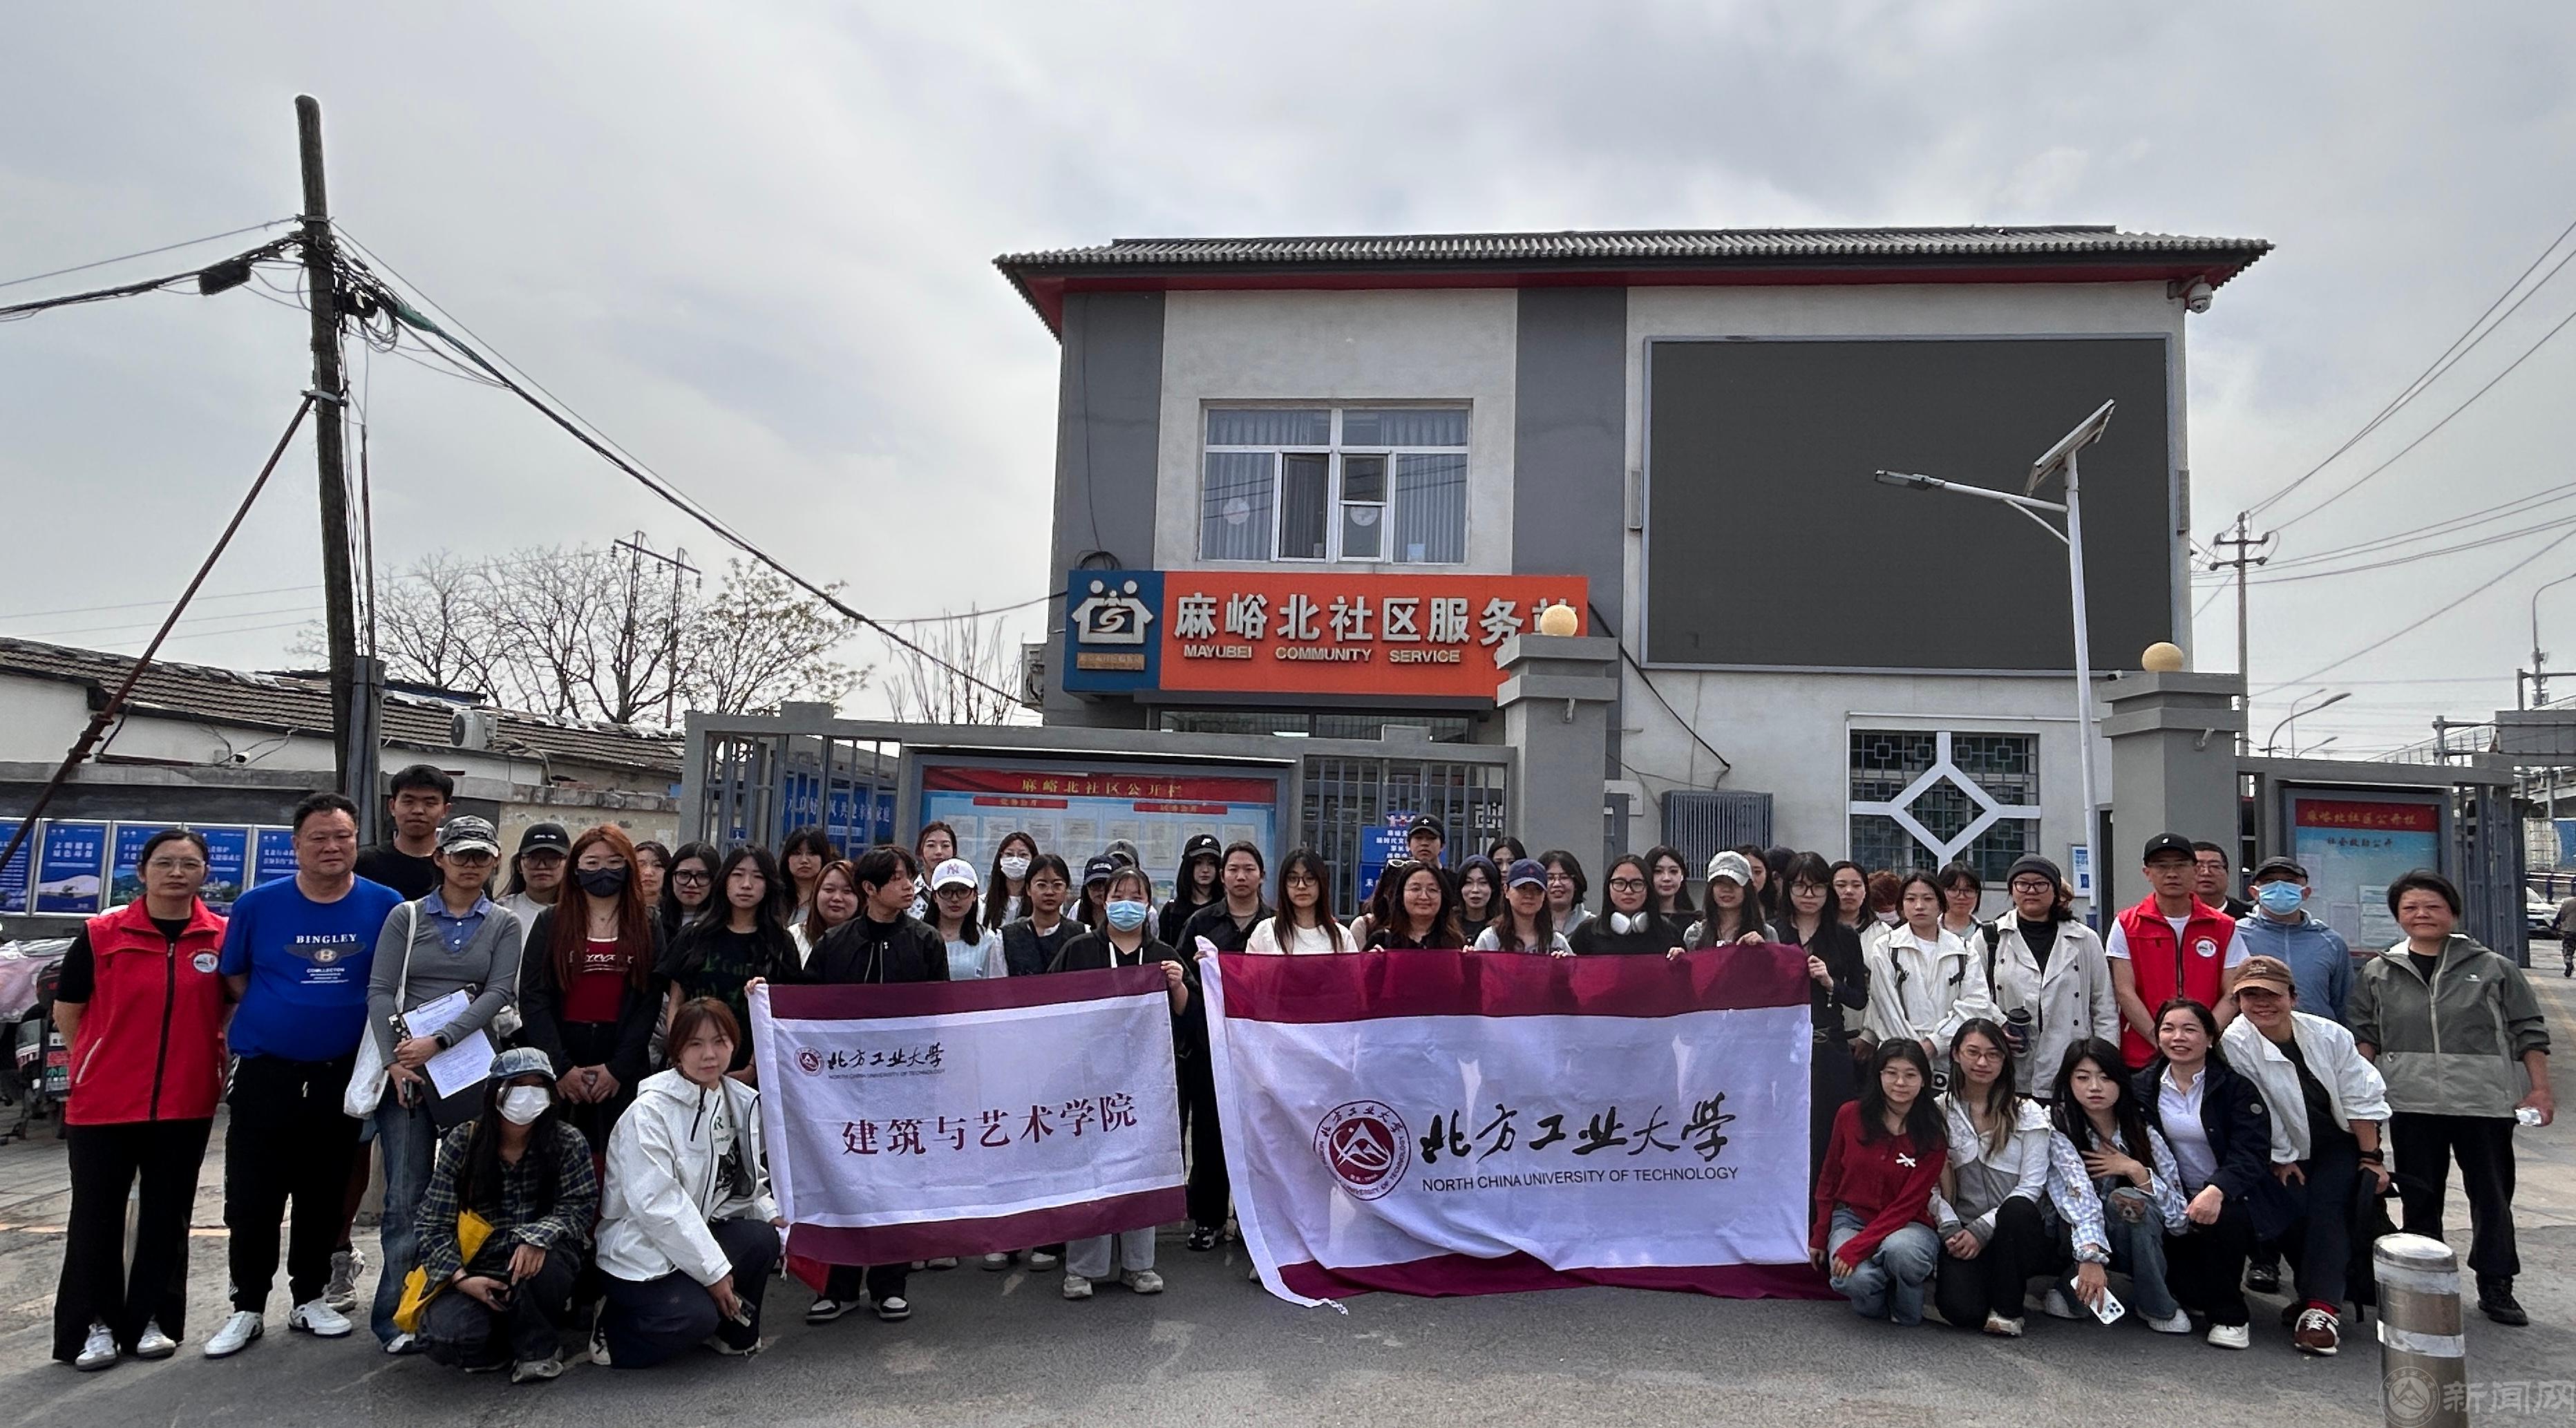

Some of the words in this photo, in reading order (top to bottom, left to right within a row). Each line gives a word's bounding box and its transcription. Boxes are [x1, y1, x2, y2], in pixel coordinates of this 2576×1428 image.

[1184, 645, 1252, 658] MAYUBEI
[1276, 646, 1372, 661] COMMUNITY
[1390, 649, 1461, 663] SERVICE
[296, 934, 357, 944] BINGLEY
[828, 1042, 945, 1069] 北方工业大学
[842, 1092, 1137, 1156] 建筑与艺术学院
[1419, 1091, 1736, 1164] 北方工业大学
[1422, 1177, 1473, 1192] NORTH
[1477, 1174, 1522, 1189] CHINA
[1524, 1170, 1605, 1186] UNIVERSITY
[1609, 1170, 1629, 1182] OF
[1633, 1167, 1738, 1182] TECHNOLOGY
